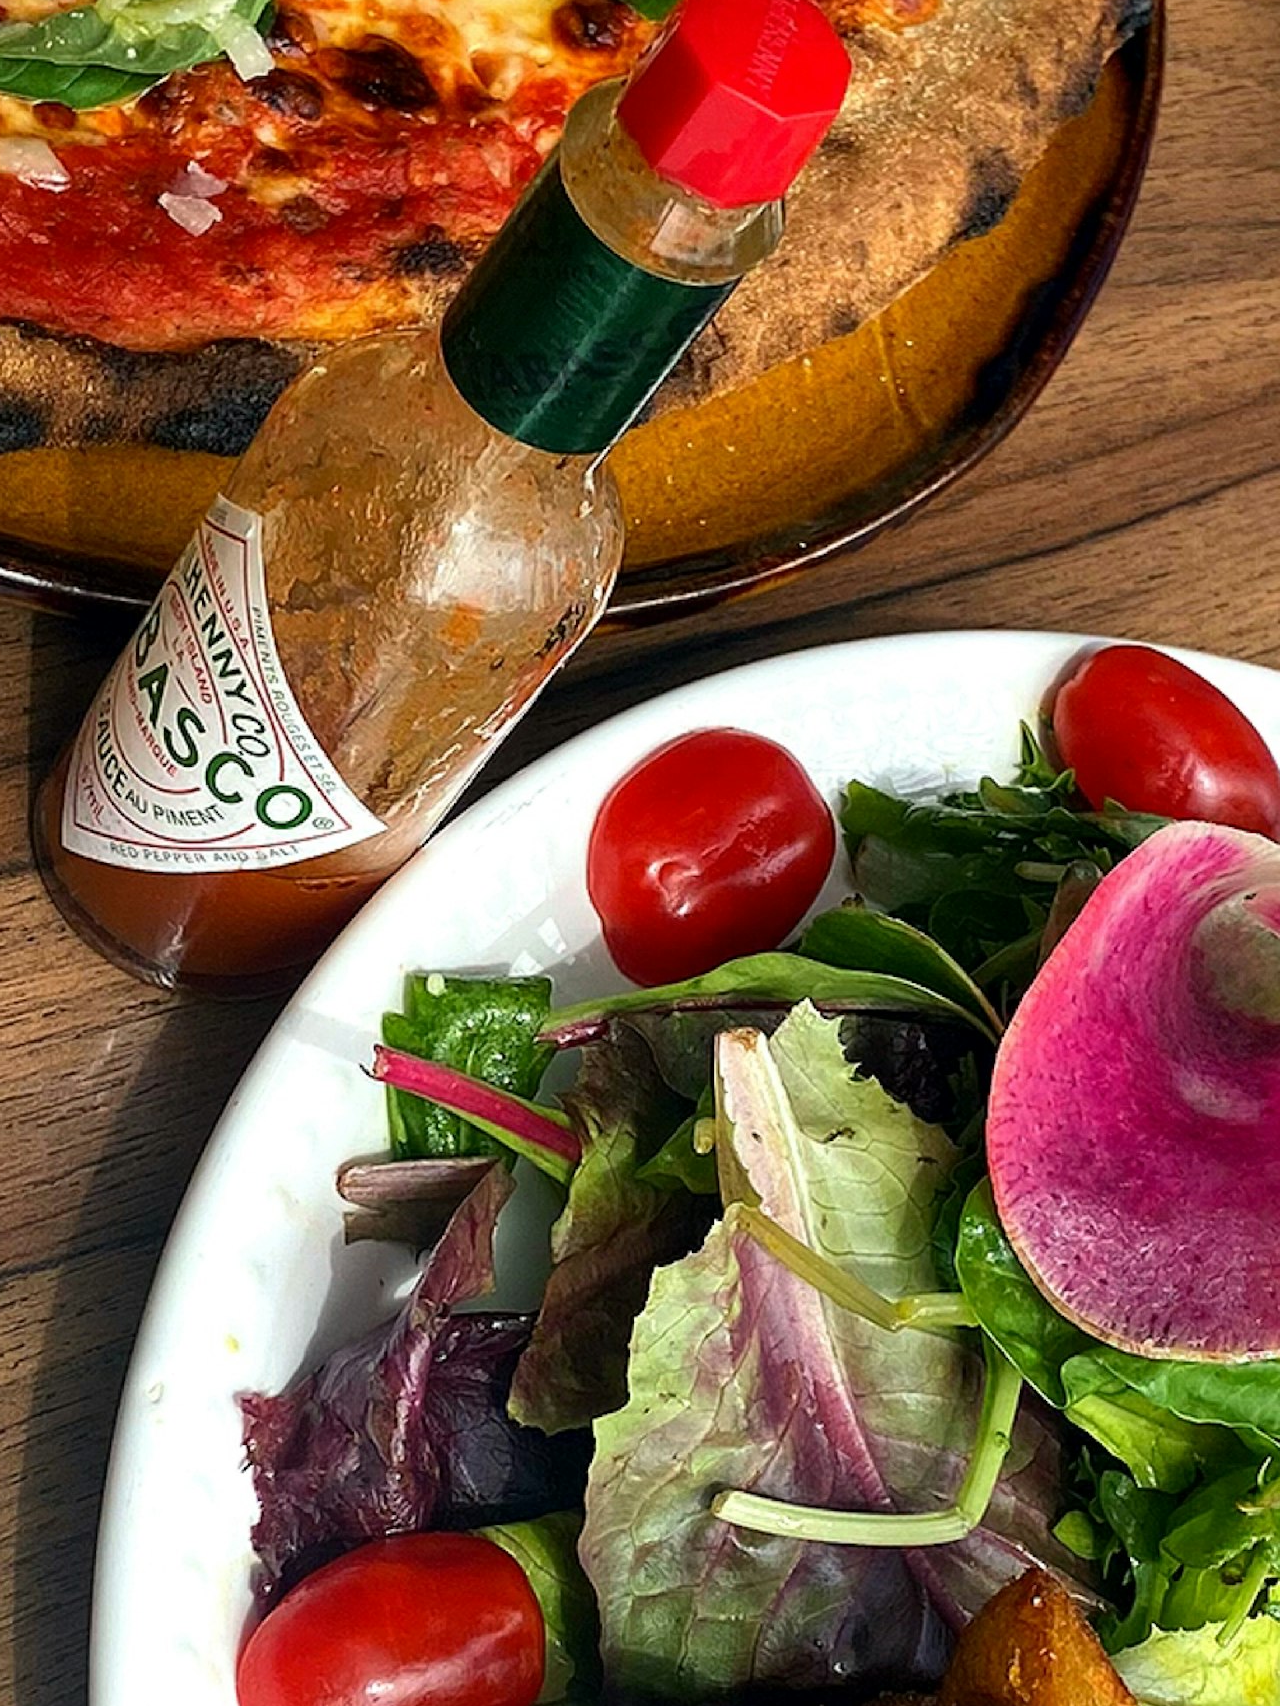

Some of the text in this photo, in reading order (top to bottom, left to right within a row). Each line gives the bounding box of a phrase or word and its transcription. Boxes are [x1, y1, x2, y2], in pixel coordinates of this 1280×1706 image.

[253, 606, 278, 684] PIMENTS
[272, 690, 312, 753] ROUGES
[309, 751, 325, 770] ET
[125, 793, 149, 814] AU
[153, 803, 225, 828] PIMENT
[109, 841, 299, 864] RED PEPPER AND SALT
